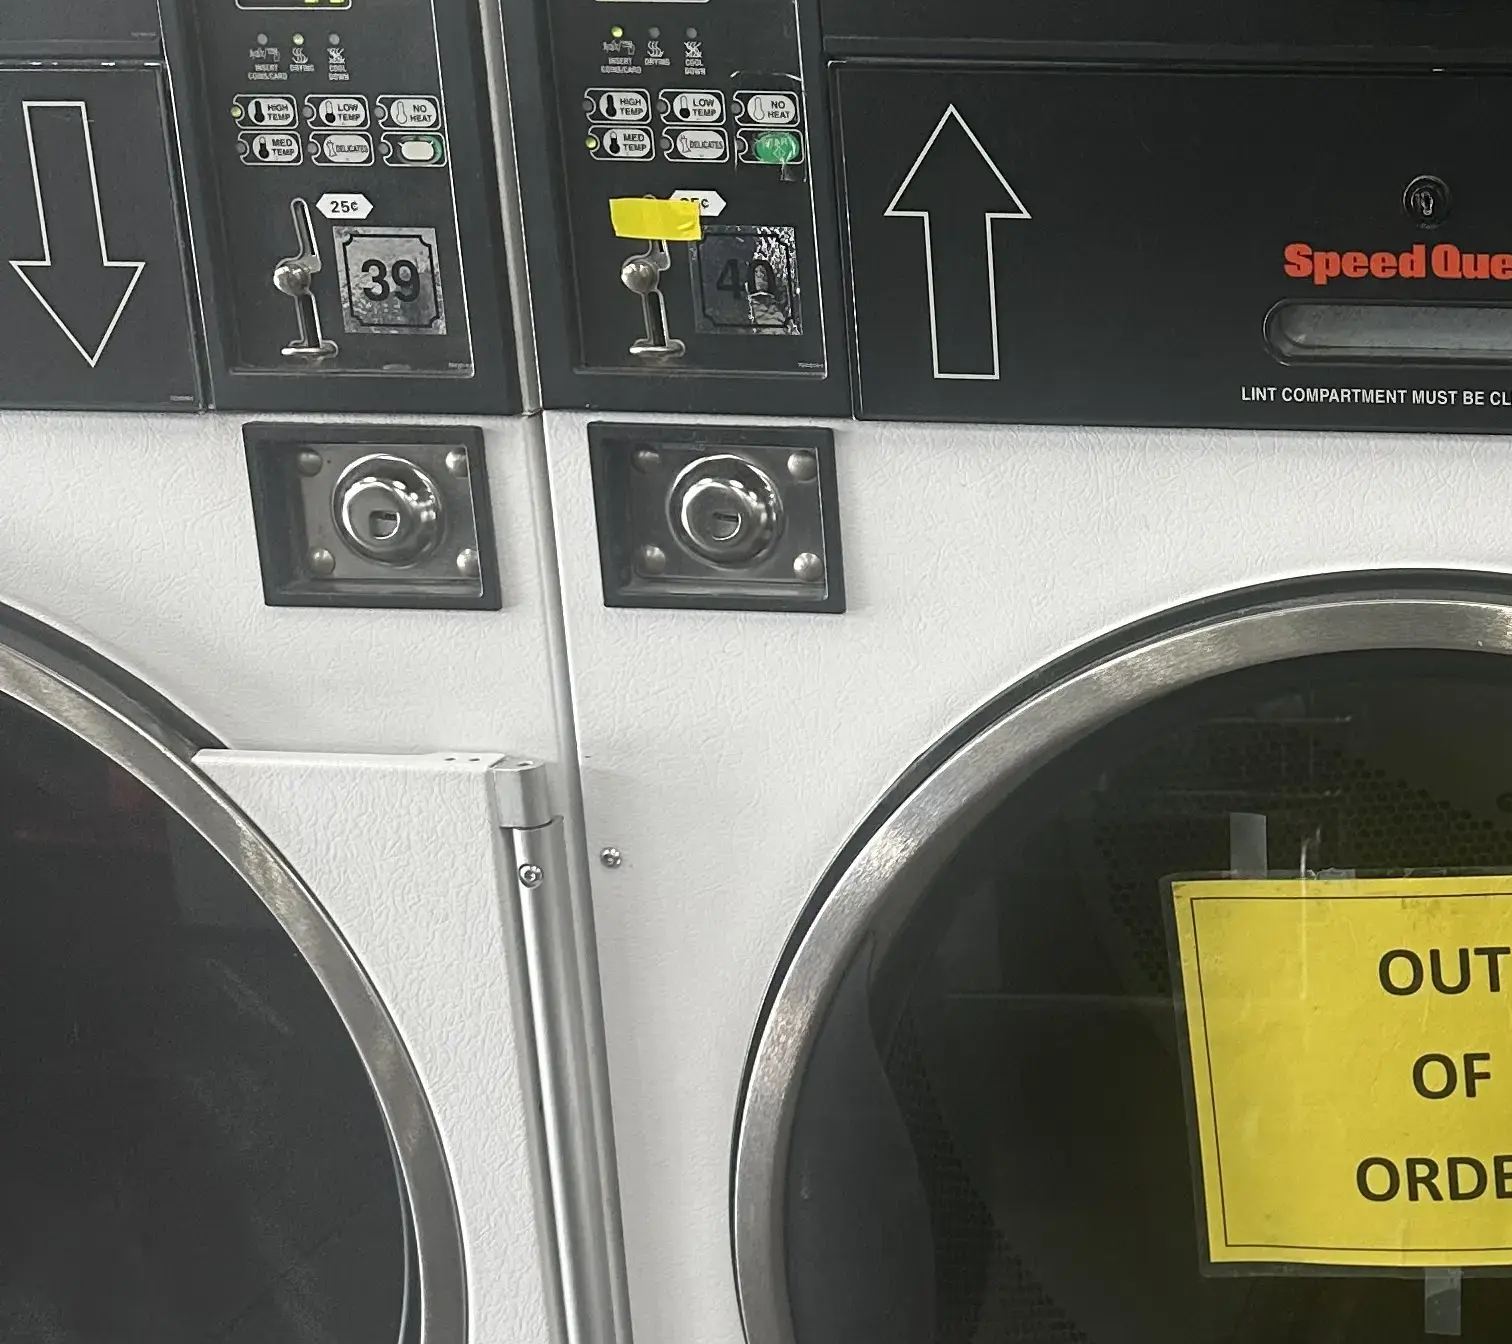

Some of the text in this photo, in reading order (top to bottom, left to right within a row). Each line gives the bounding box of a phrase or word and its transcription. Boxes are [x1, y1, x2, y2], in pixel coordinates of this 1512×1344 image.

[619, 97, 642, 105] HIGH
[692, 98, 715, 107] LOW
[771, 100, 785, 109] NO
[267, 103, 288, 112] HIGH
[337, 103, 359, 112] LOW
[413, 104, 427, 113] NO
[620, 107, 644, 116] TEMP
[268, 112, 291, 121] TEMP
[338, 112, 361, 121] TEMP
[692, 108, 716, 117] TEMP
[768, 110, 790, 119] HEAT
[410, 114, 433, 123] HEAT
[623, 133, 645, 142] MED
[271, 138, 293, 147] MED
[623, 142, 646, 152] TEMP
[689, 139, 723, 149] DELICATES
[271, 147, 295, 156] TEMP
[330, 200, 359, 214] 25¢
[1283, 243, 1426, 285] Speed
[361, 259, 421, 303] 39
[1241, 387, 1277, 402] LINT
[1281, 387, 1408, 405] COMPARTMENT
[1412, 389, 1459, 406] MUST
[1463, 391, 1485, 406] BE
[1378, 946, 1511, 997] OUT
[1412, 1052, 1492, 1100] OF
